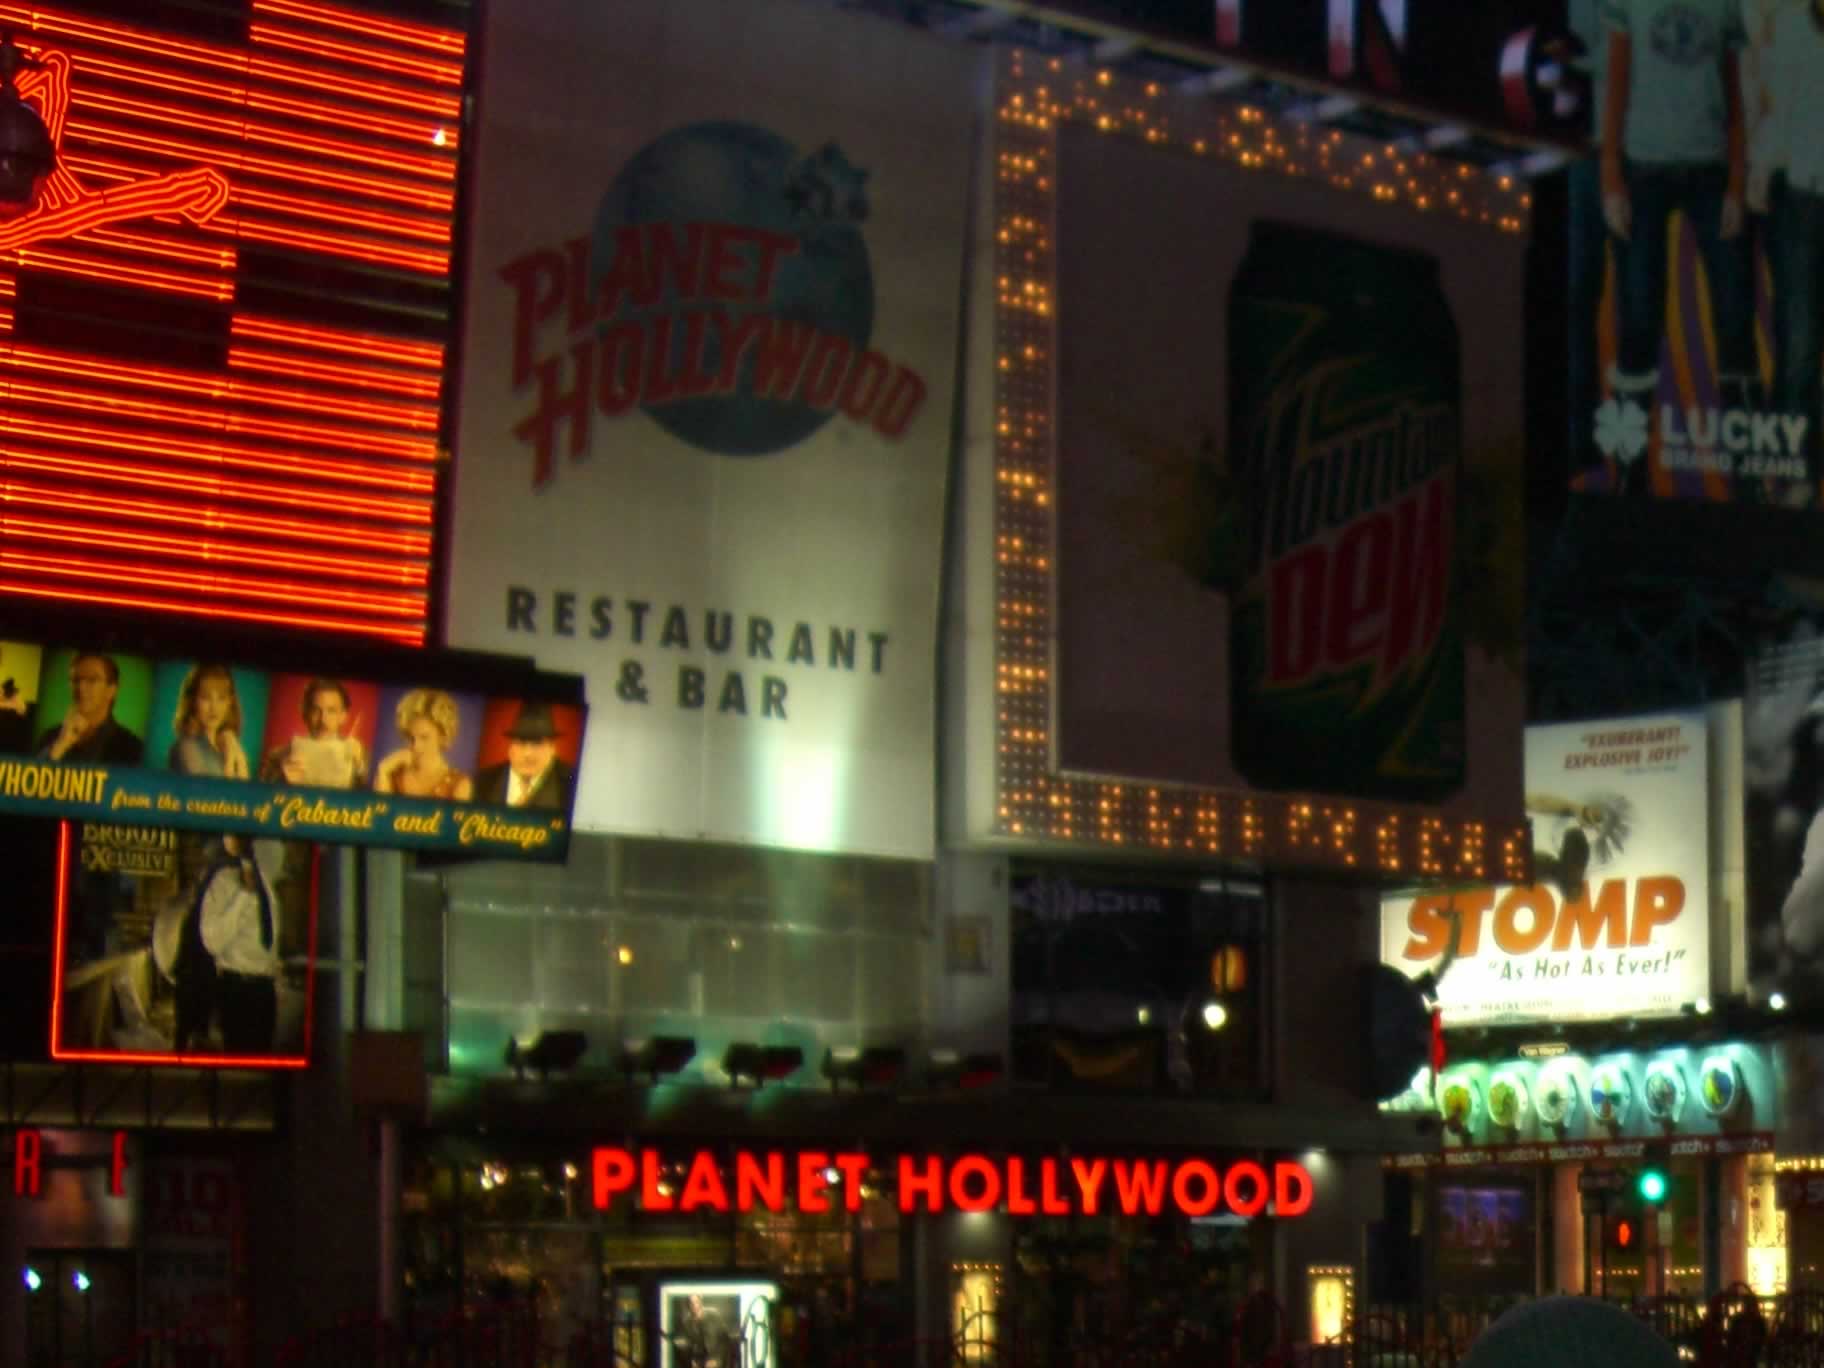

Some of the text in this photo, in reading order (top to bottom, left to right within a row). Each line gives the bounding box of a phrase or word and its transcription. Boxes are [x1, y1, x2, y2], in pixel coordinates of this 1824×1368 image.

[497, 219, 800, 394] PLANET
[512, 309, 928, 493] HOLLYWOOD
[1660, 403, 1808, 453] LUCKY
[1741, 455, 1807, 477] JEANS
[507, 587, 889, 673] RESTAURANT
[616, 661, 787, 719] & BAR
[0, 760, 563, 848] HODUNIT from the creators of "Cabaret" and "Chicago"
[1402, 876, 1686, 961] STOMP
[1582, 954, 1606, 976] As
[591, 1145, 1315, 1217] PLANET HOLLYWOOD
